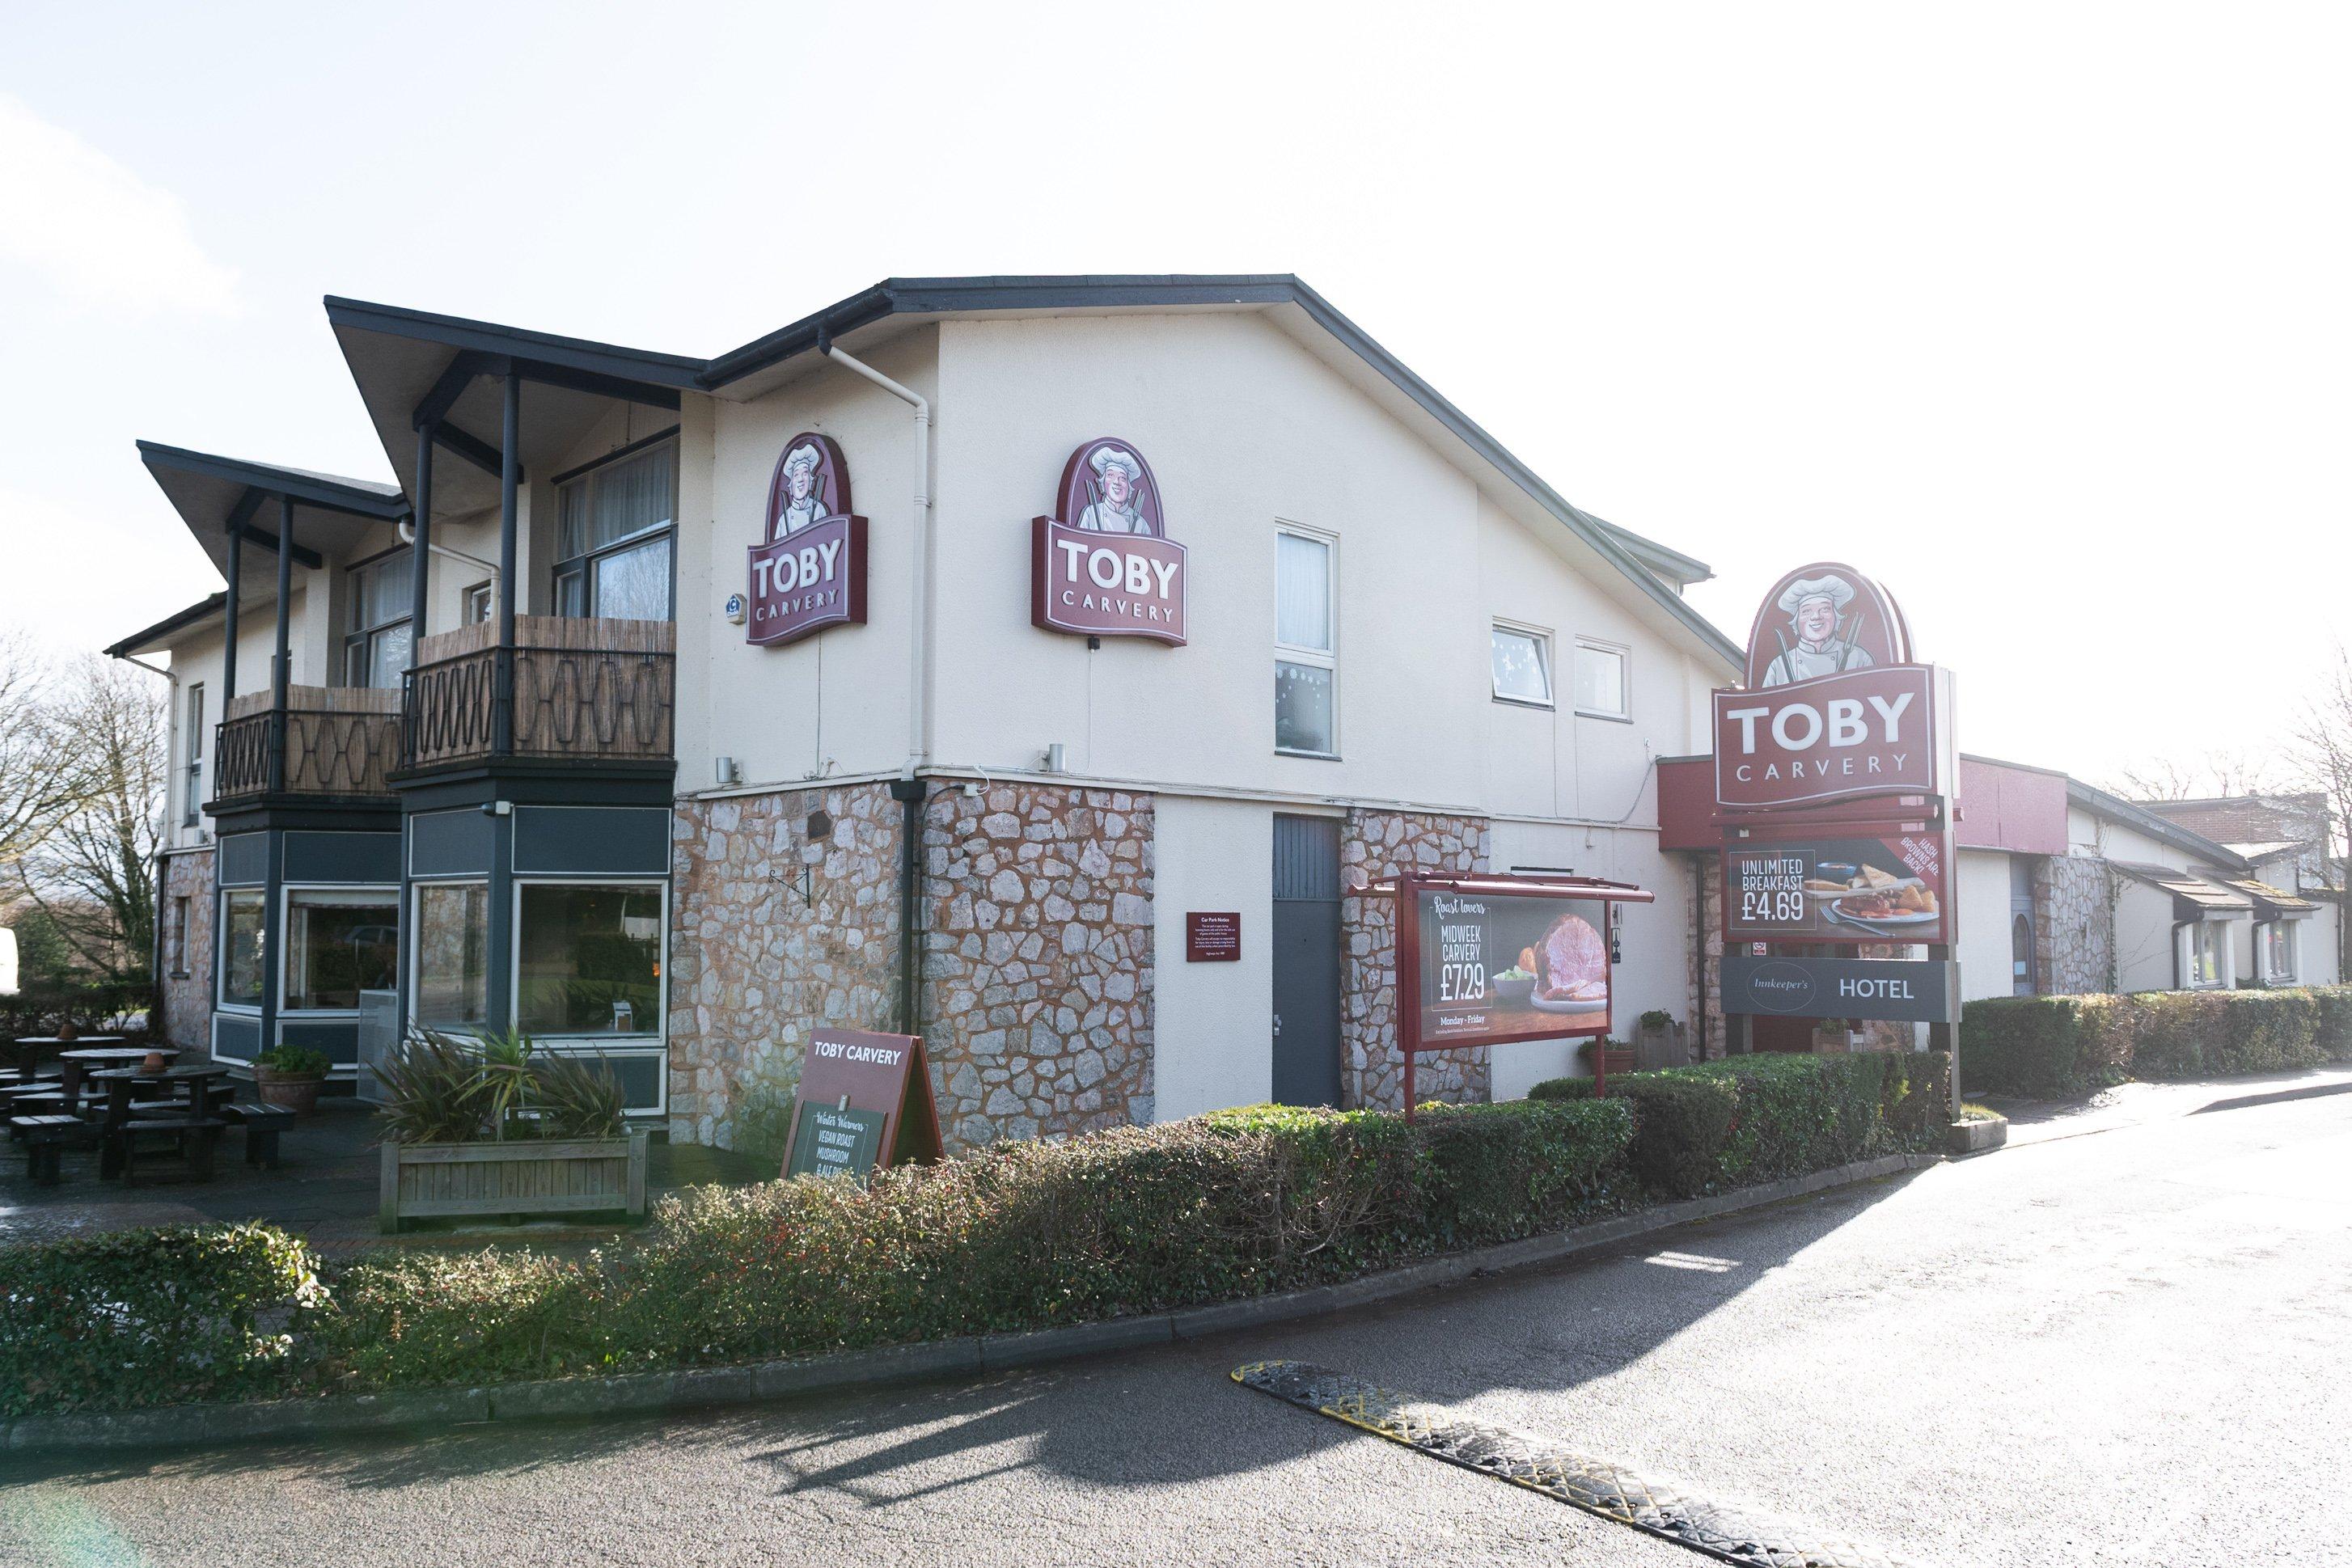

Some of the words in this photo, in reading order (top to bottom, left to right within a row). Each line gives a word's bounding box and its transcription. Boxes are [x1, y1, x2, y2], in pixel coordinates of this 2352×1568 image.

[752, 539, 843, 599] TOBY
[1056, 539, 1179, 600] TOBY
[755, 590, 840, 622] CARVERY
[1061, 589, 1174, 623] CARVERY
[1727, 692, 1915, 754] TOBY
[1737, 753, 1907, 782] CARVERY
[1901, 836, 1931, 865] BROWNS
[1926, 861, 1940, 877] ARE
[1918, 838, 1939, 859] HASH
[1742, 859, 1803, 876] UNLIMITED
[1902, 853, 1925, 875] BACK!
[1742, 876, 1804, 892] BREAKFAST
[1434, 896, 1460, 919] Roast
[1461, 898, 1486, 915] lovers
[1741, 893, 1804, 921] £4.69
[1441, 925, 1481, 943] MIDWEEK
[1442, 944, 1481, 962] CARVERY
[1440, 963, 1485, 1001] £7.29
[1754, 977, 1808, 991] Innkeeper's
[1839, 978, 1914, 1000] HOTEL
[1440, 1016, 1464, 1026] Monday
[1467, 1014, 1486, 1025] Friday
[814, 1041, 845, 1058] TOBY
[846, 1045, 902, 1066] CARVERY
[837, 1114, 865, 1132] Warmers
[819, 1130, 837, 1145] VEGAN
[835, 1133, 856, 1147] ROAST
[816, 1146, 849, 1164] MUSHROOM
